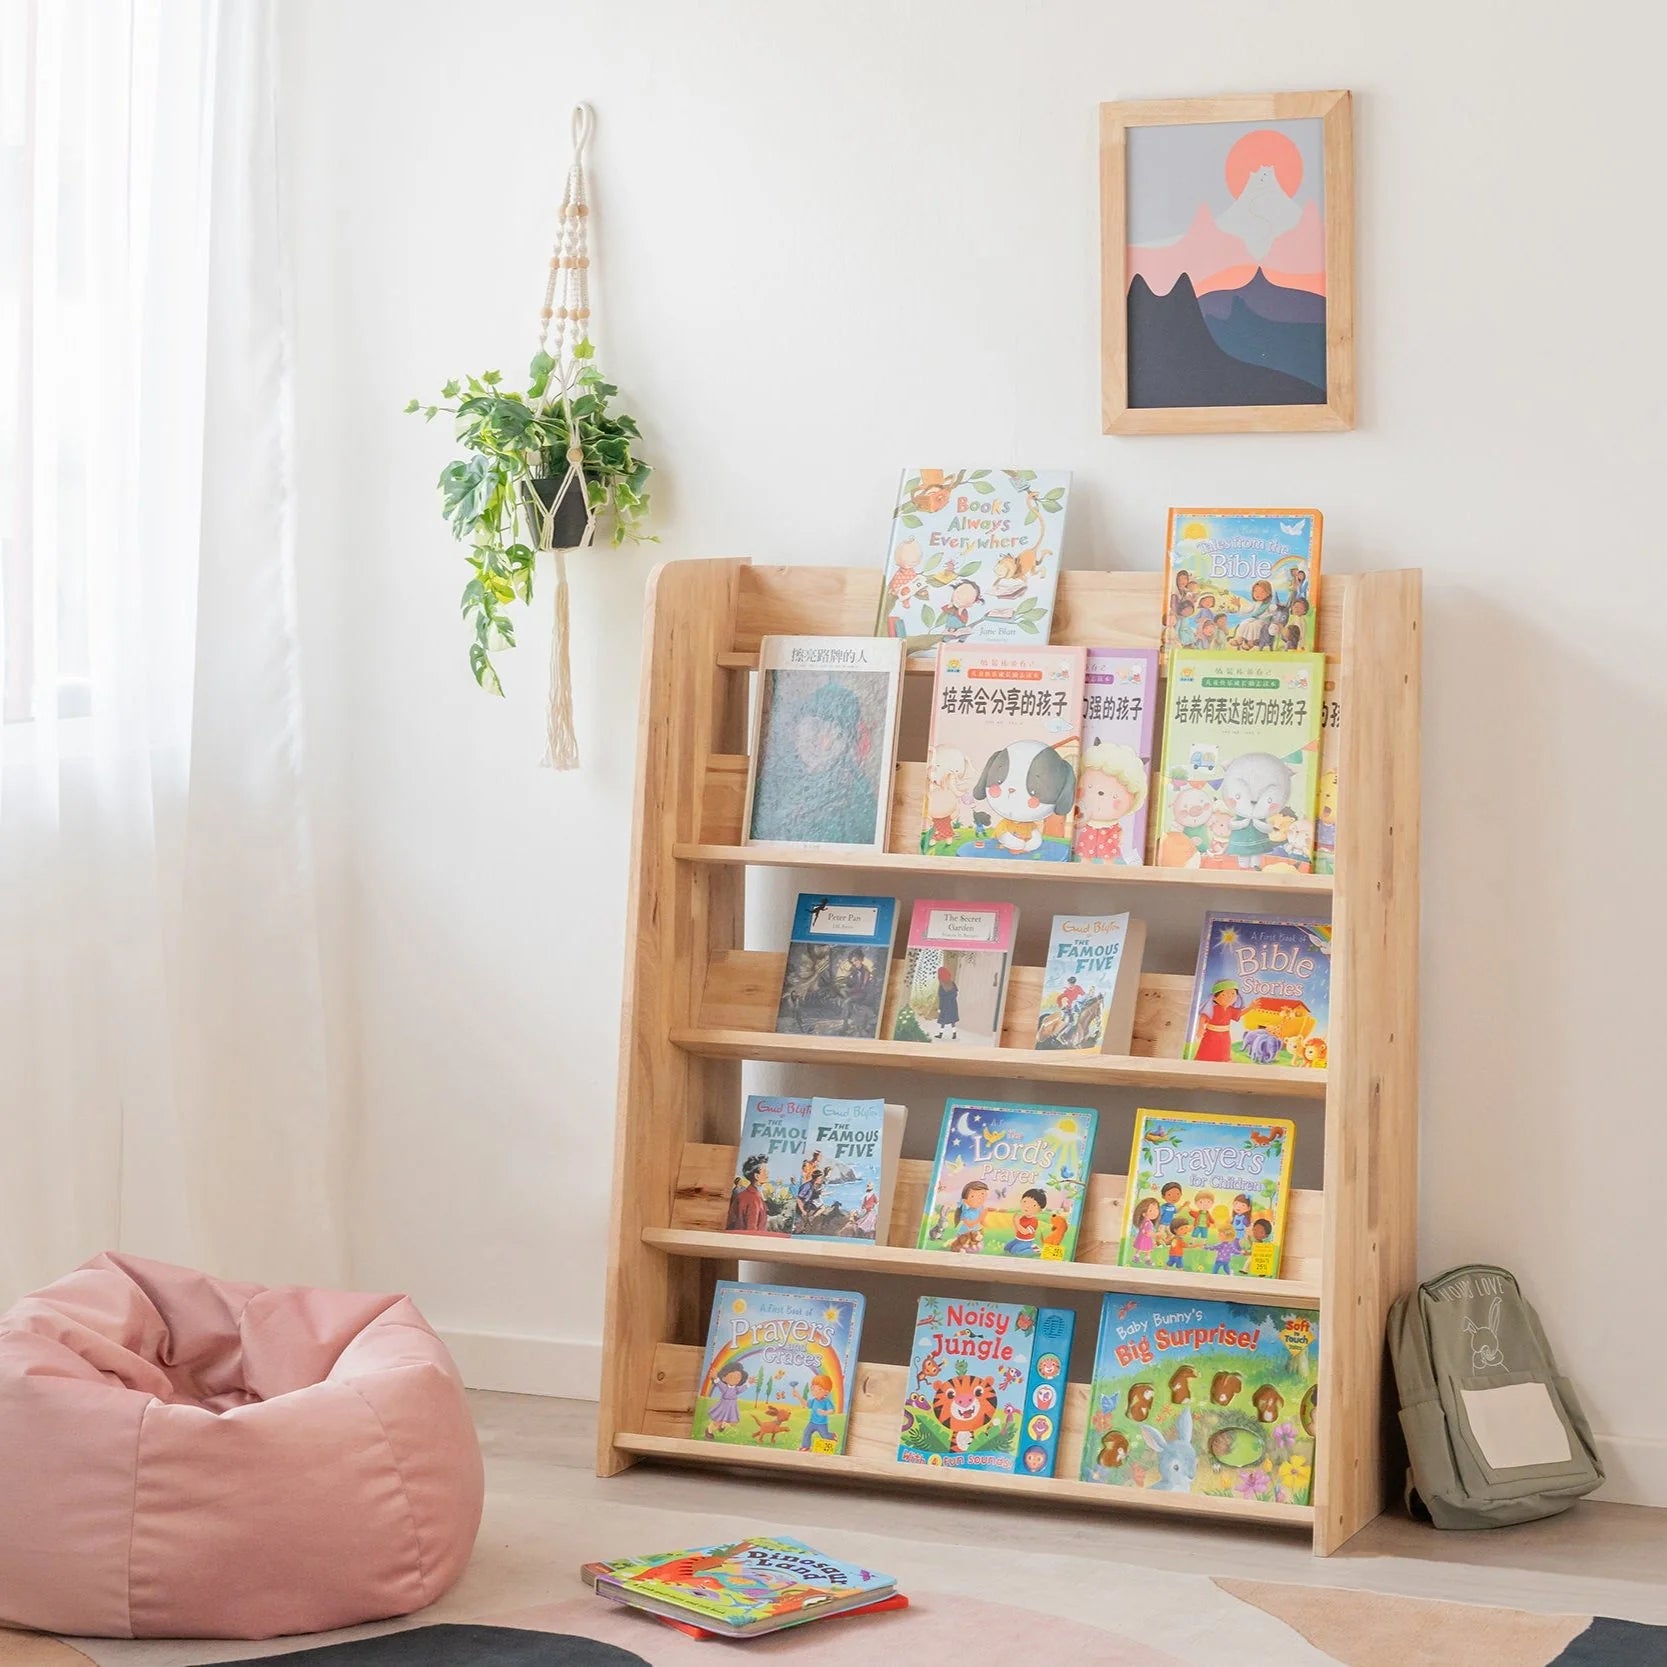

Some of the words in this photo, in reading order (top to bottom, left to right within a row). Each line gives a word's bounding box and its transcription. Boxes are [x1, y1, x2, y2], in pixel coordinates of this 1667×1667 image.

[956, 496, 1011, 514] Books
[947, 516, 1011, 535] Always
[929, 532, 1029, 556] Everywhere
[1209, 553, 1273, 579] Bible
[790, 647, 868, 664] 擦亮路牌的人
[941, 685, 1068, 718] 培养会分享的孩子
[1174, 694, 1308, 727] 培养有表达能力的孩子
[828, 912, 847, 922] Peter
[848, 913, 862, 922] Pan
[944, 913, 959, 921] The
[960, 915, 982, 923] Secret
[1062, 920, 1091, 934] Enid
[948, 923, 974, 932] Garden
[1250, 931, 1258, 940] A
[1259, 932, 1277, 941] First
[1279, 932, 1298, 943] Book
[1056, 942, 1120, 959] FAMOUS
[1075, 956, 1115, 974] FIVE
[1235, 943, 1316, 979] Bible
[1241, 976, 1304, 997] Stories
[756, 1100, 784, 1115] Enid
[767, 1119, 783, 1127] THE
[816, 1126, 879, 1143] FAMOUS
[835, 1143, 876, 1159] FIVE
[970, 1135, 1056, 1169] Lord's
[1154, 1146, 1265, 1178] Prayers
[981, 1163, 1041, 1186] Prayer
[1189, 1173, 1208, 1188] for
[1209, 1174, 1264, 1193] Children
[1474, 1276, 1505, 1297] LOVE
[760, 1304, 768, 1313] A
[768, 1304, 785, 1314] First
[786, 1303, 802, 1316] Book
[946, 1305, 1010, 1335] Noisy
[1116, 1319, 1148, 1340] Baby
[1152, 1308, 1204, 1326] Bunny's
[1286, 1319, 1310, 1333] Soft
[729, 1318, 836, 1349] Prayers
[1284, 1335, 1309, 1345] Touch
[931, 1333, 1014, 1361] Jungle
[1114, 1335, 1155, 1368] Big
[1154, 1323, 1261, 1352] Surprise!
[762, 1345, 823, 1368] Graces
[747, 1550, 848, 1584] Dinosaur
[756, 1559, 827, 1580] Land
